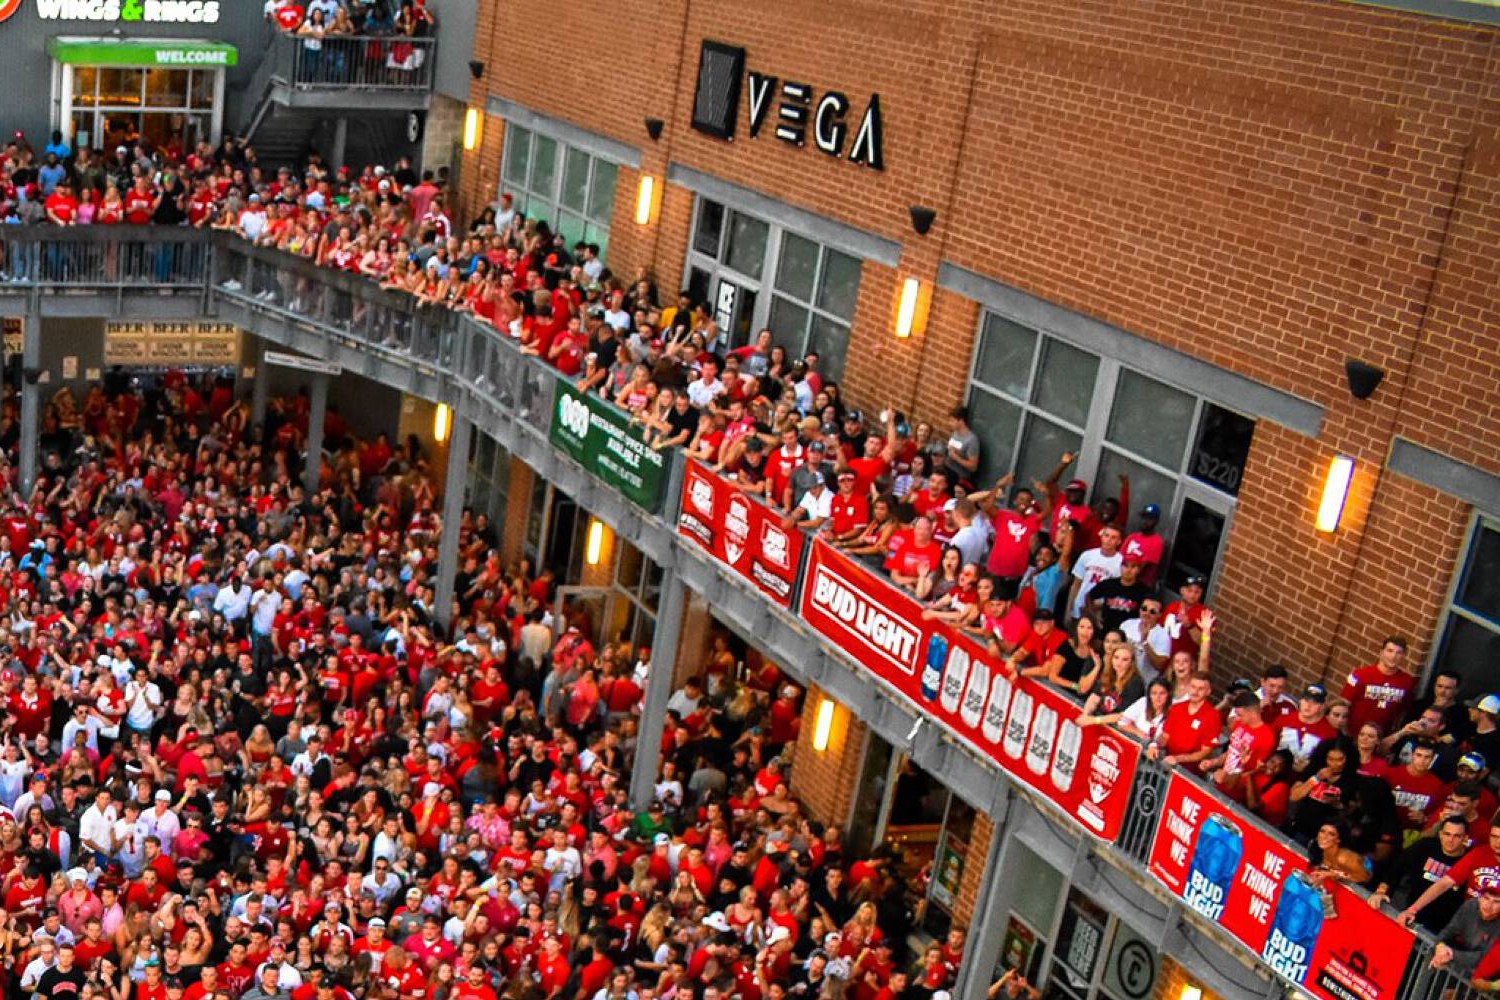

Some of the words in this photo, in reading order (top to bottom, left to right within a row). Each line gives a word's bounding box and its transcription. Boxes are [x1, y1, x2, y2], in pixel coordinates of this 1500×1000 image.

[37, 0, 120, 20] WINGS
[121, 0, 143, 21] &
[144, 1, 219, 22] RINGS
[155, 50, 227, 63] WELCOME
[749, 72, 883, 170] VEGA
[107, 322, 143, 334] BEER
[153, 322, 189, 334] BEER
[197, 322, 235, 334] BEER
[1198, 452, 1239, 488] S220
[816, 572, 857, 628] BUD
[857, 600, 916, 663] LIGHT
[1180, 796, 1201, 825] WE
[1167, 809, 1195, 846] THINK
[1169, 840, 1189, 867] WE
[1263, 850, 1286, 880] WE
[1190, 871, 1224, 902] BUD
[1241, 863, 1278, 901] THINK
[1183, 881, 1224, 920] LIGHT
[1248, 897, 1271, 925] WE
[1270, 928, 1306, 959] BUD
[1263, 941, 1307, 986] LIGHT
